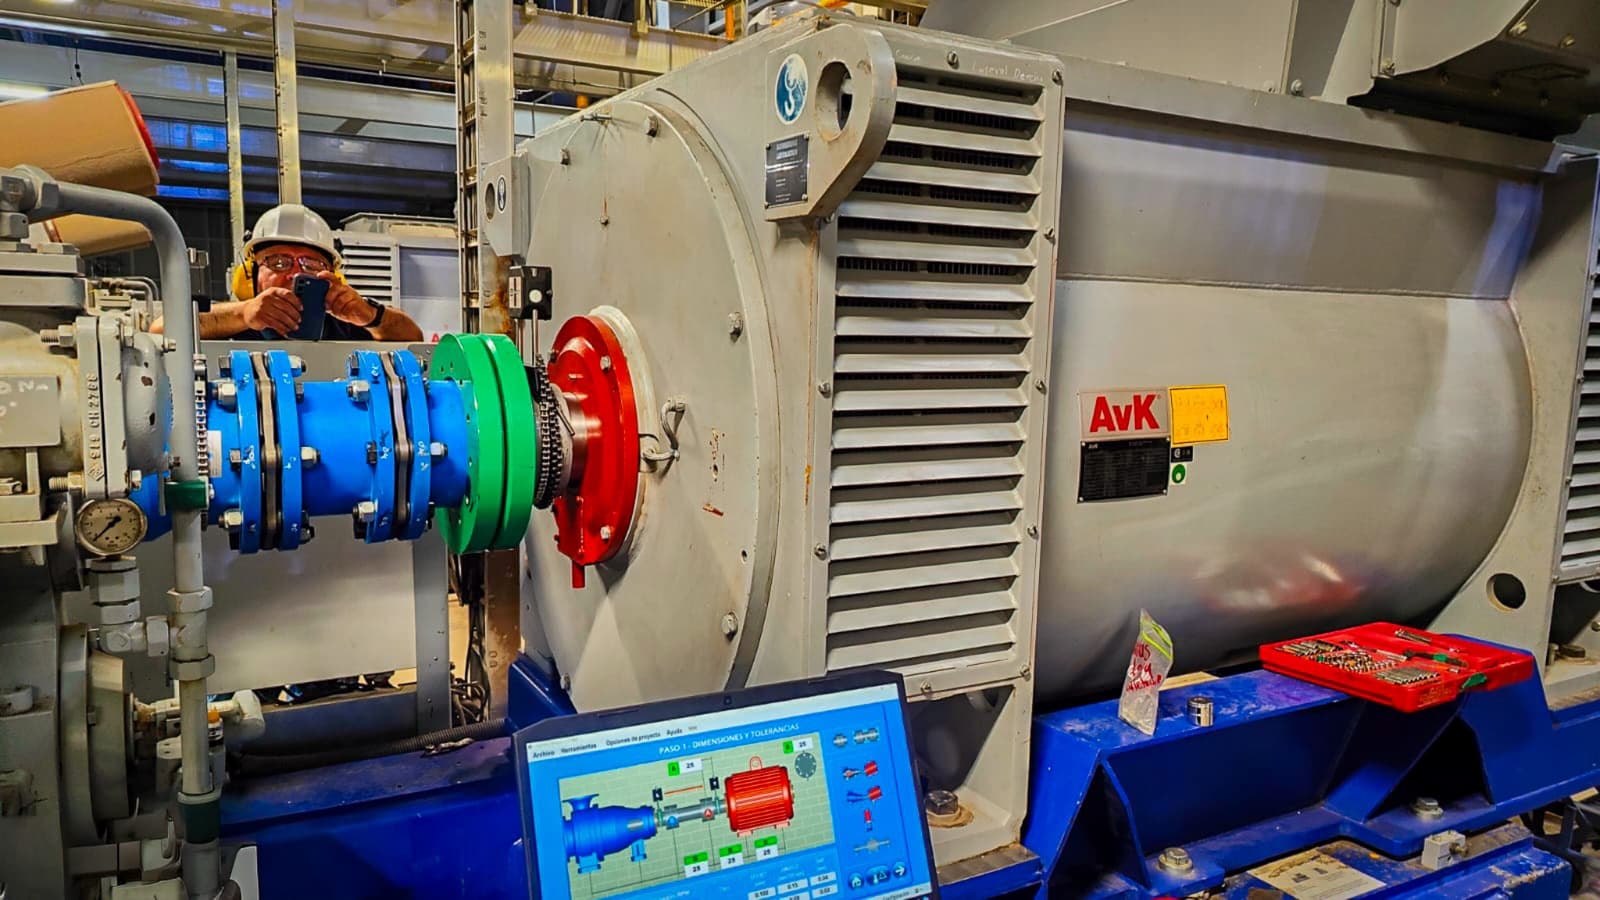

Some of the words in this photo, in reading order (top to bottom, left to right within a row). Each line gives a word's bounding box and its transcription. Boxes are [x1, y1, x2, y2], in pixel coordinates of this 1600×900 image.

[1089, 393, 1160, 433] AvK
[659, 744, 681, 755] PASO
[692, 734, 743, 748] DIMENSIONES
[751, 723, 800, 738] TOLERANCIAS
